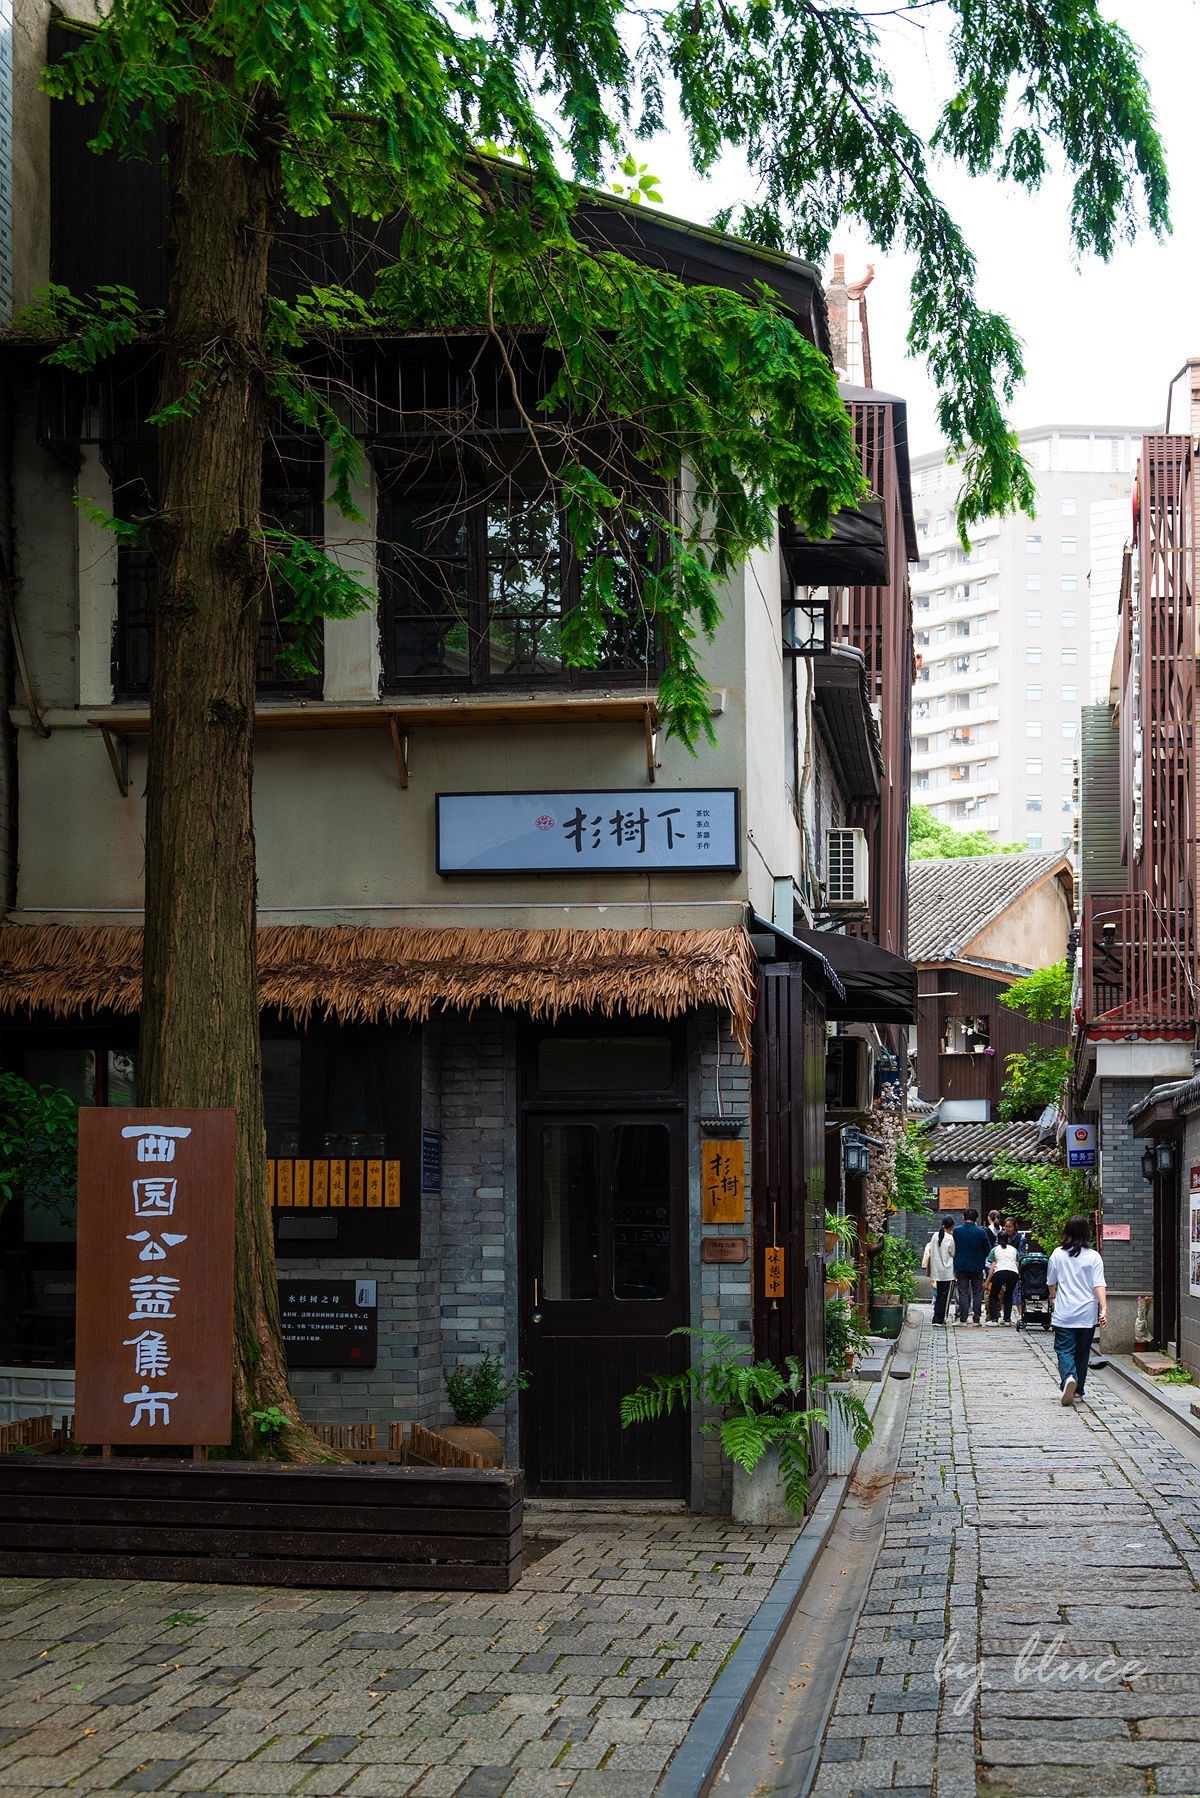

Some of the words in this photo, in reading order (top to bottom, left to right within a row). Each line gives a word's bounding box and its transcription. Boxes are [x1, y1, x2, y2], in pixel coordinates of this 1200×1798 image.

[696, 809, 710, 817] 茶饮
[696, 820, 710, 828] 茶点
[562, 806, 686, 854] 杉樹下
[696, 831, 710, 839] 茶器
[696, 842, 710, 850] 手作
[121, 1125, 192, 1426] 西园公益集市
[288, 1294, 340, 1304] 水杉树之母
